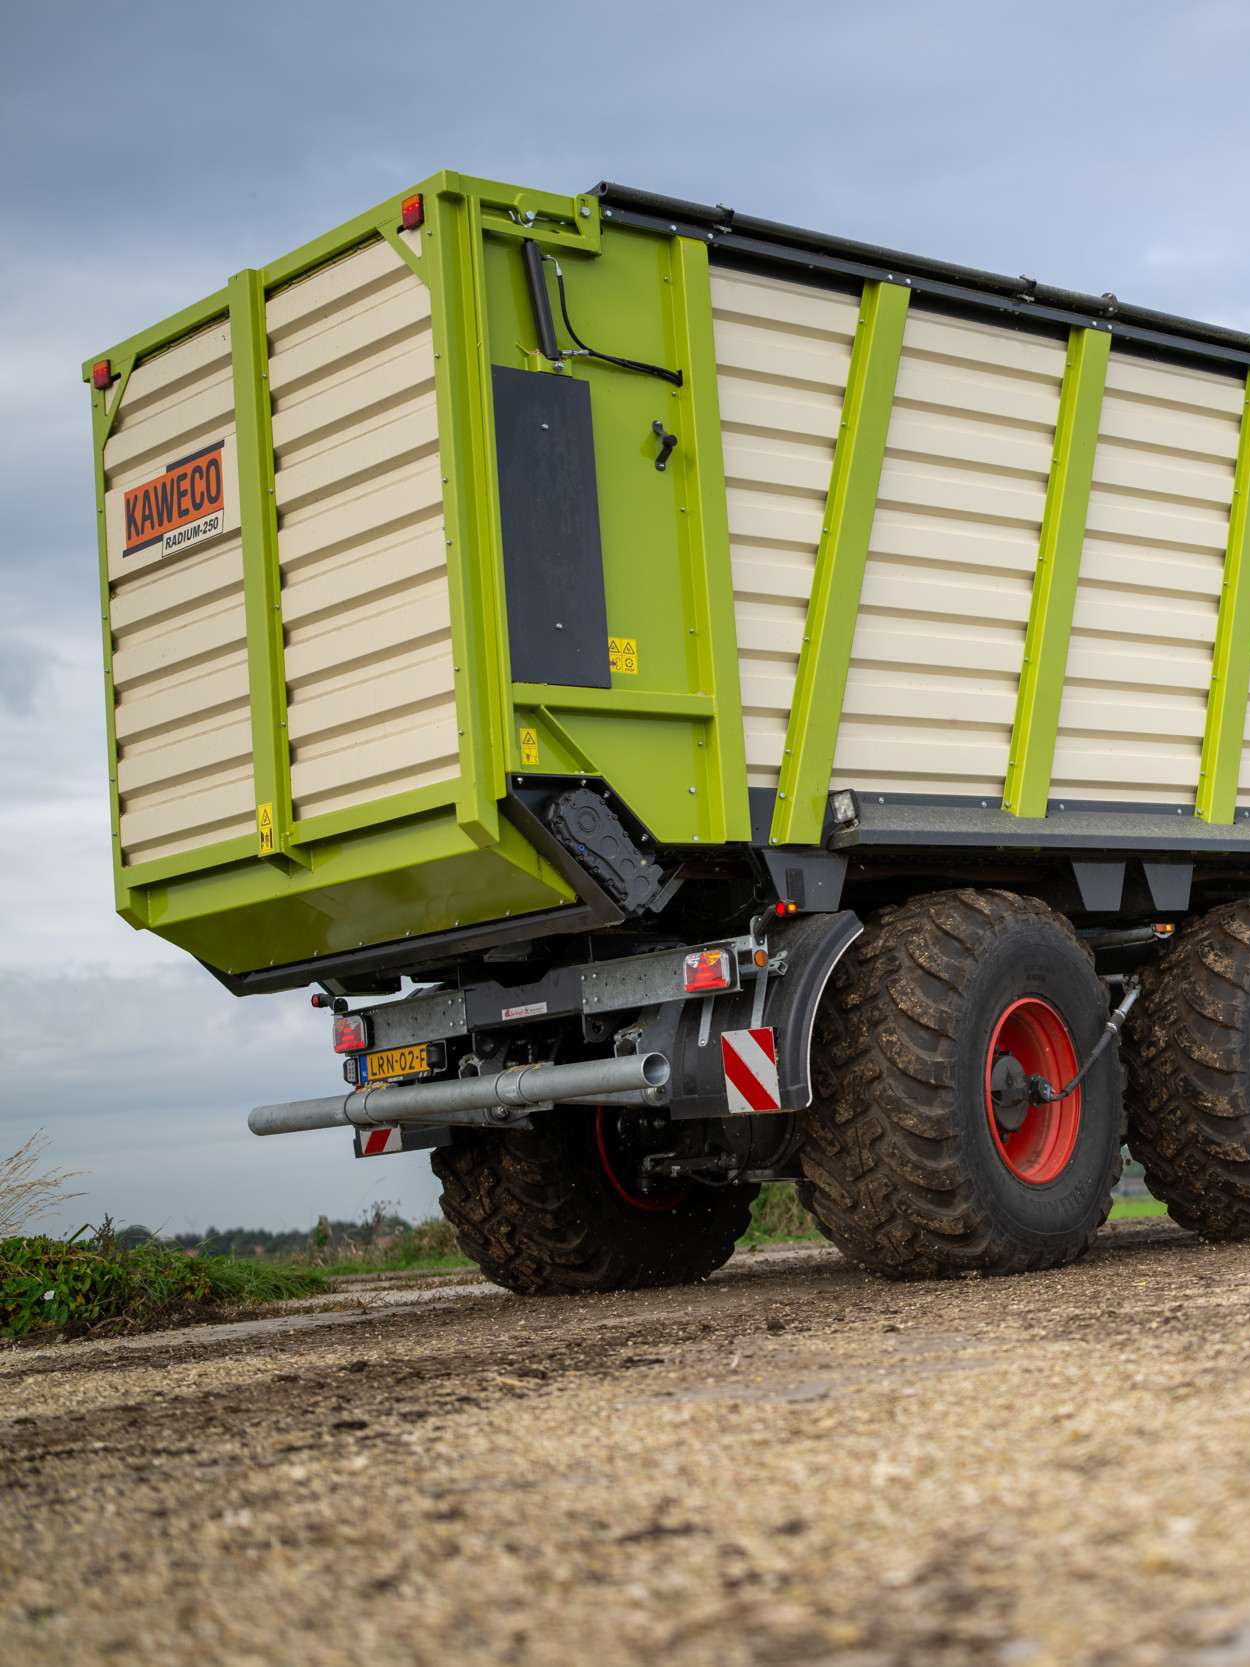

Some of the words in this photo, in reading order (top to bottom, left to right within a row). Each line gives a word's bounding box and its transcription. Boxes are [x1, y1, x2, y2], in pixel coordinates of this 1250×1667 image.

[126, 458, 221, 541] KAWECO
[165, 517, 219, 550] RADIUM-250
[370, 1048, 425, 1077] LRN-02-F
